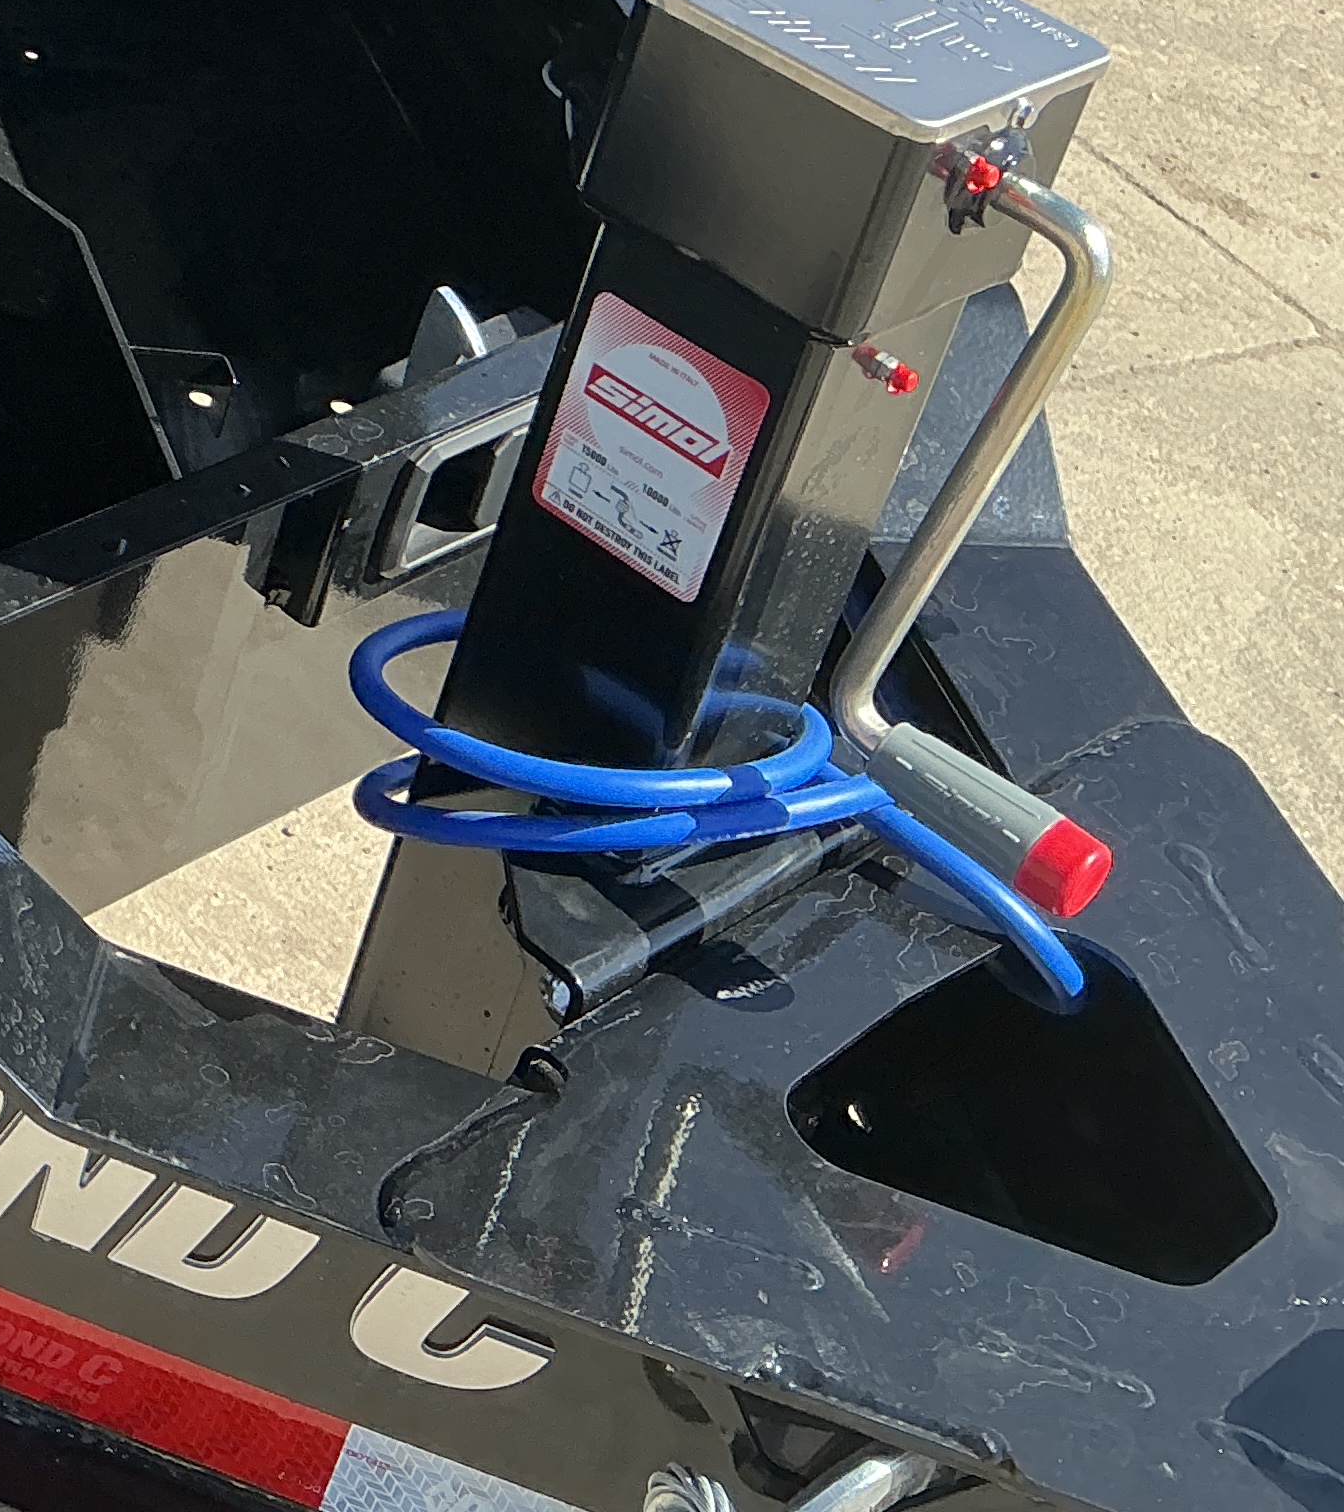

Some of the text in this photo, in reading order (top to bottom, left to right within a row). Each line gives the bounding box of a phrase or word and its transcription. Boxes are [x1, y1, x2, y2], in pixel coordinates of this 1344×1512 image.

[562, 498, 576, 513] DO
[576, 508, 594, 525] NOT
[594, 519, 633, 551] DESTROY
[633, 544, 653, 566] THIS
[653, 559, 680, 585] LABEL
[77, 1354, 125, 1386] C
